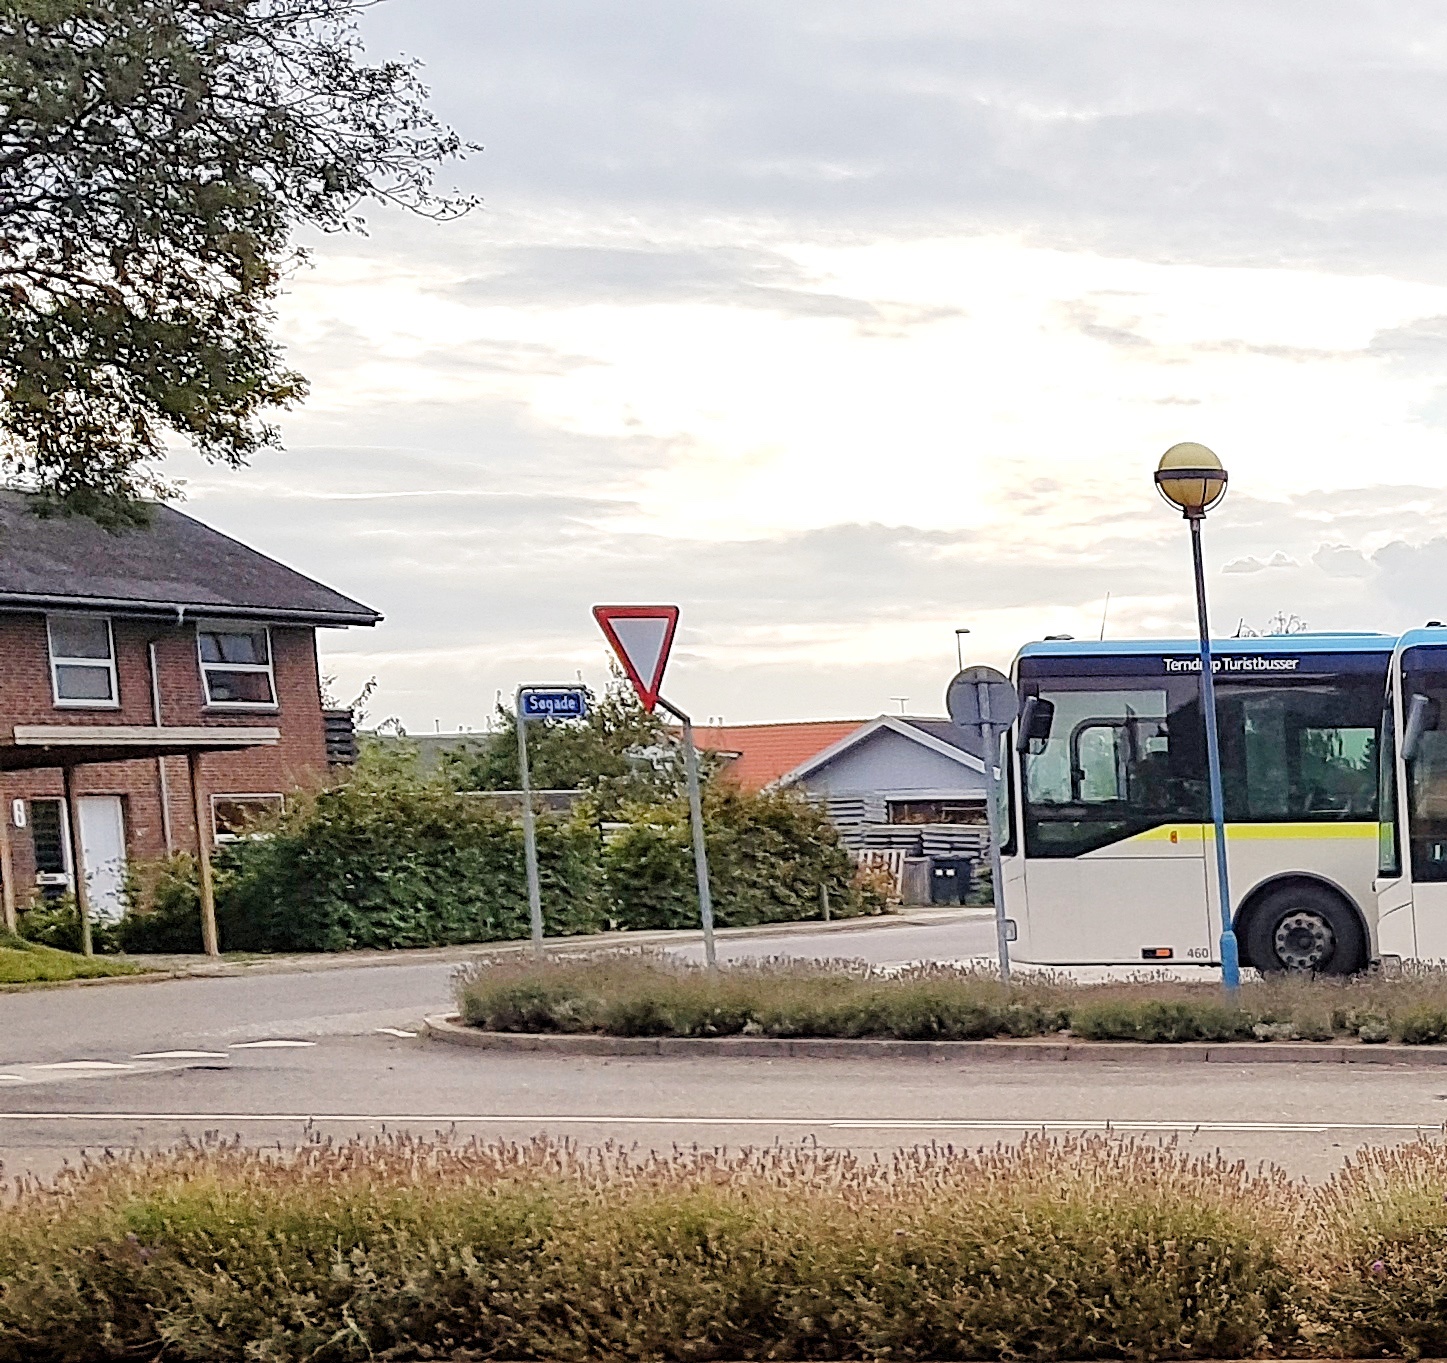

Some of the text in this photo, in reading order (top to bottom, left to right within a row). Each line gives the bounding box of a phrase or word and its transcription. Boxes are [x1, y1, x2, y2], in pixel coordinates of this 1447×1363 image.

[1222, 656, 1299, 671] Turistbusser
[529, 695, 576, 714] Søgade
[1187, 947, 1209, 958] 460
